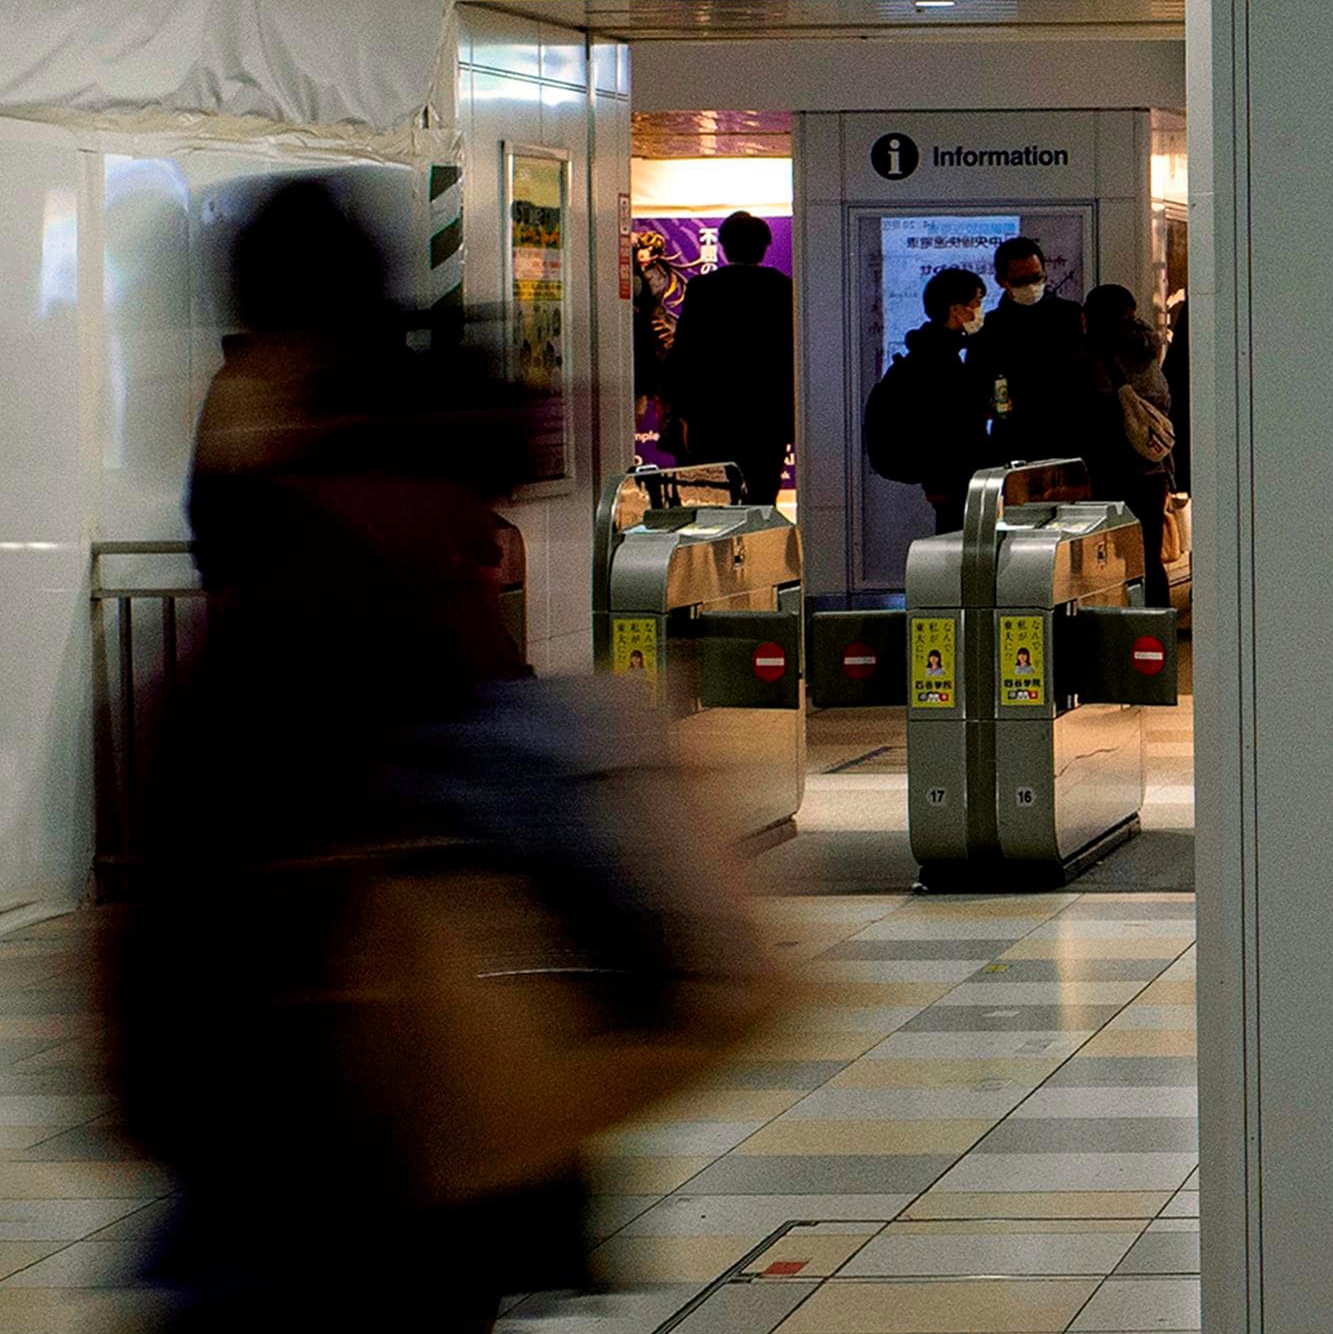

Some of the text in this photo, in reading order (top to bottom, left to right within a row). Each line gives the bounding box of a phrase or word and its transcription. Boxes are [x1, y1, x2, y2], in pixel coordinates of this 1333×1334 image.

[933, 146, 1069, 167] Information
[929, 788, 945, 804] 17
[1017, 788, 1032, 804] 16
